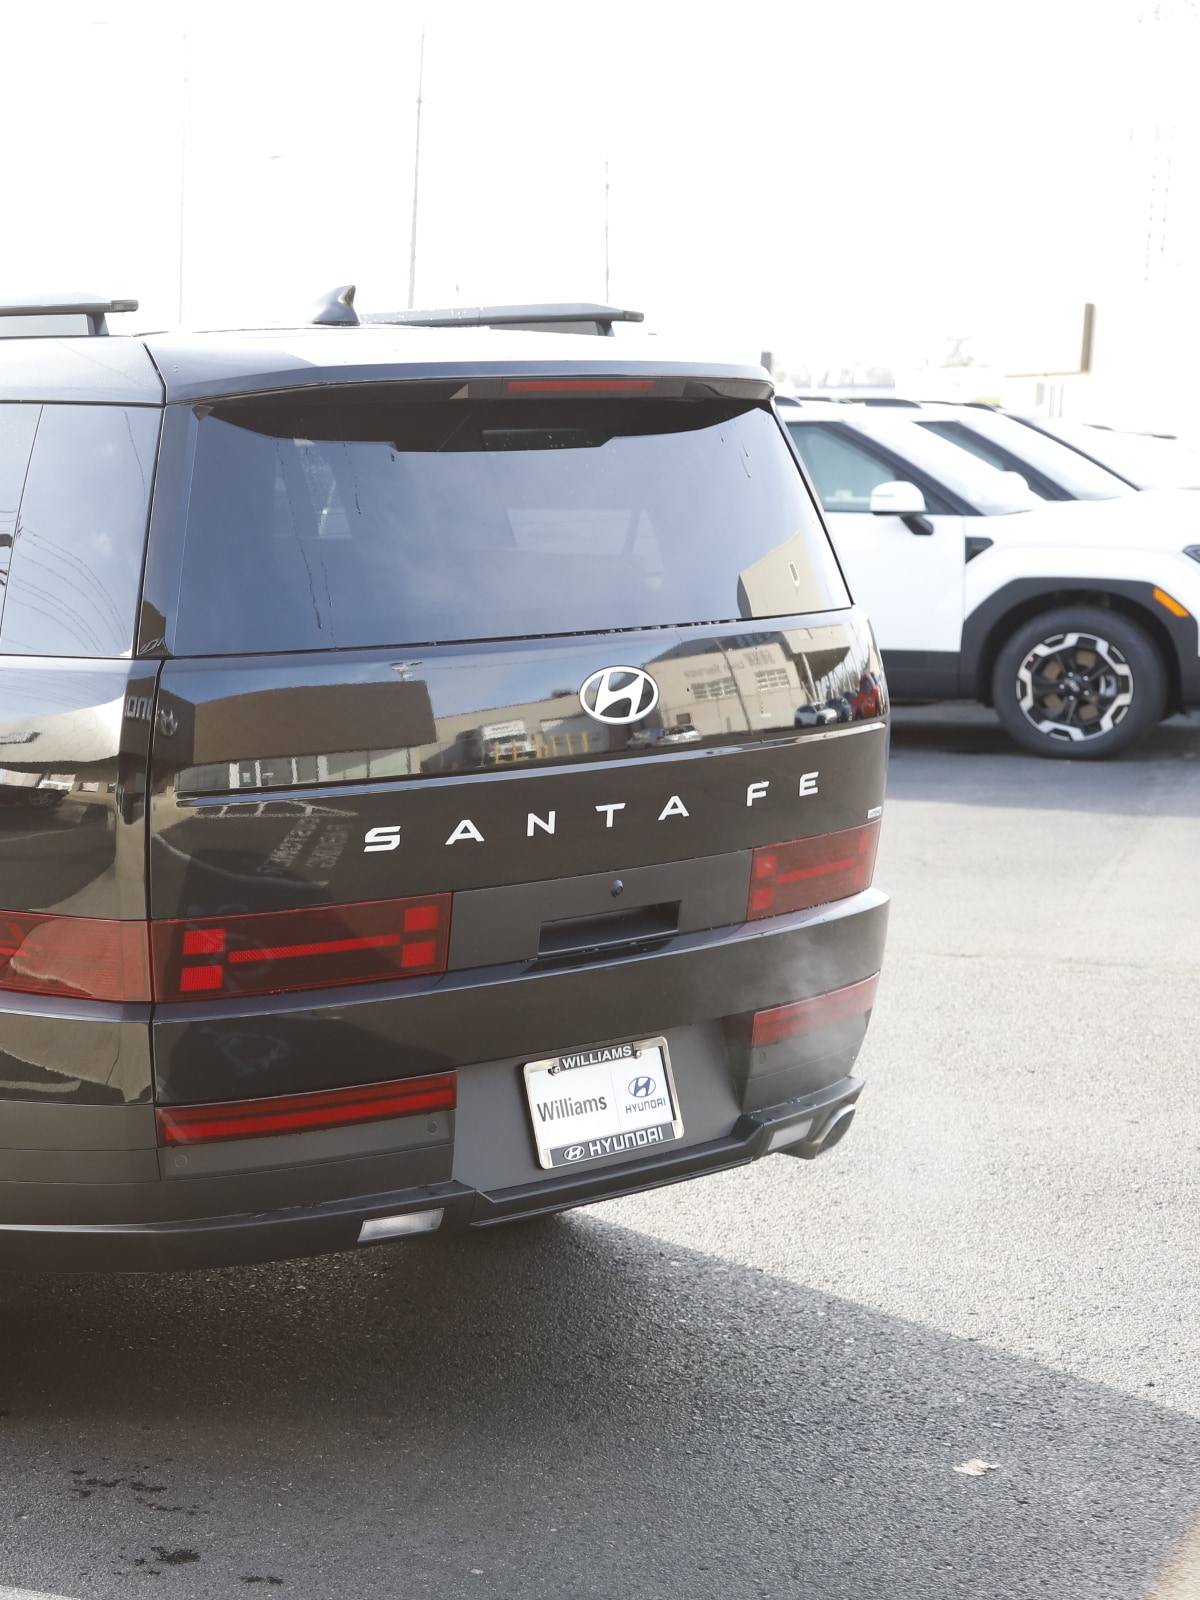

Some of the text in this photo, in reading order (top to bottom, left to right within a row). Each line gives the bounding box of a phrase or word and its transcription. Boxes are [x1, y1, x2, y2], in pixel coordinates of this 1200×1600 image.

[363, 795, 690, 853] SANTA
[746, 771, 819, 807] FE
[562, 1046, 632, 1069] WILLIAMS
[536, 1096, 608, 1122] Williams
[625, 1097, 666, 1114] HYUNDAI
[588, 1127, 664, 1157] HYUNDAI
